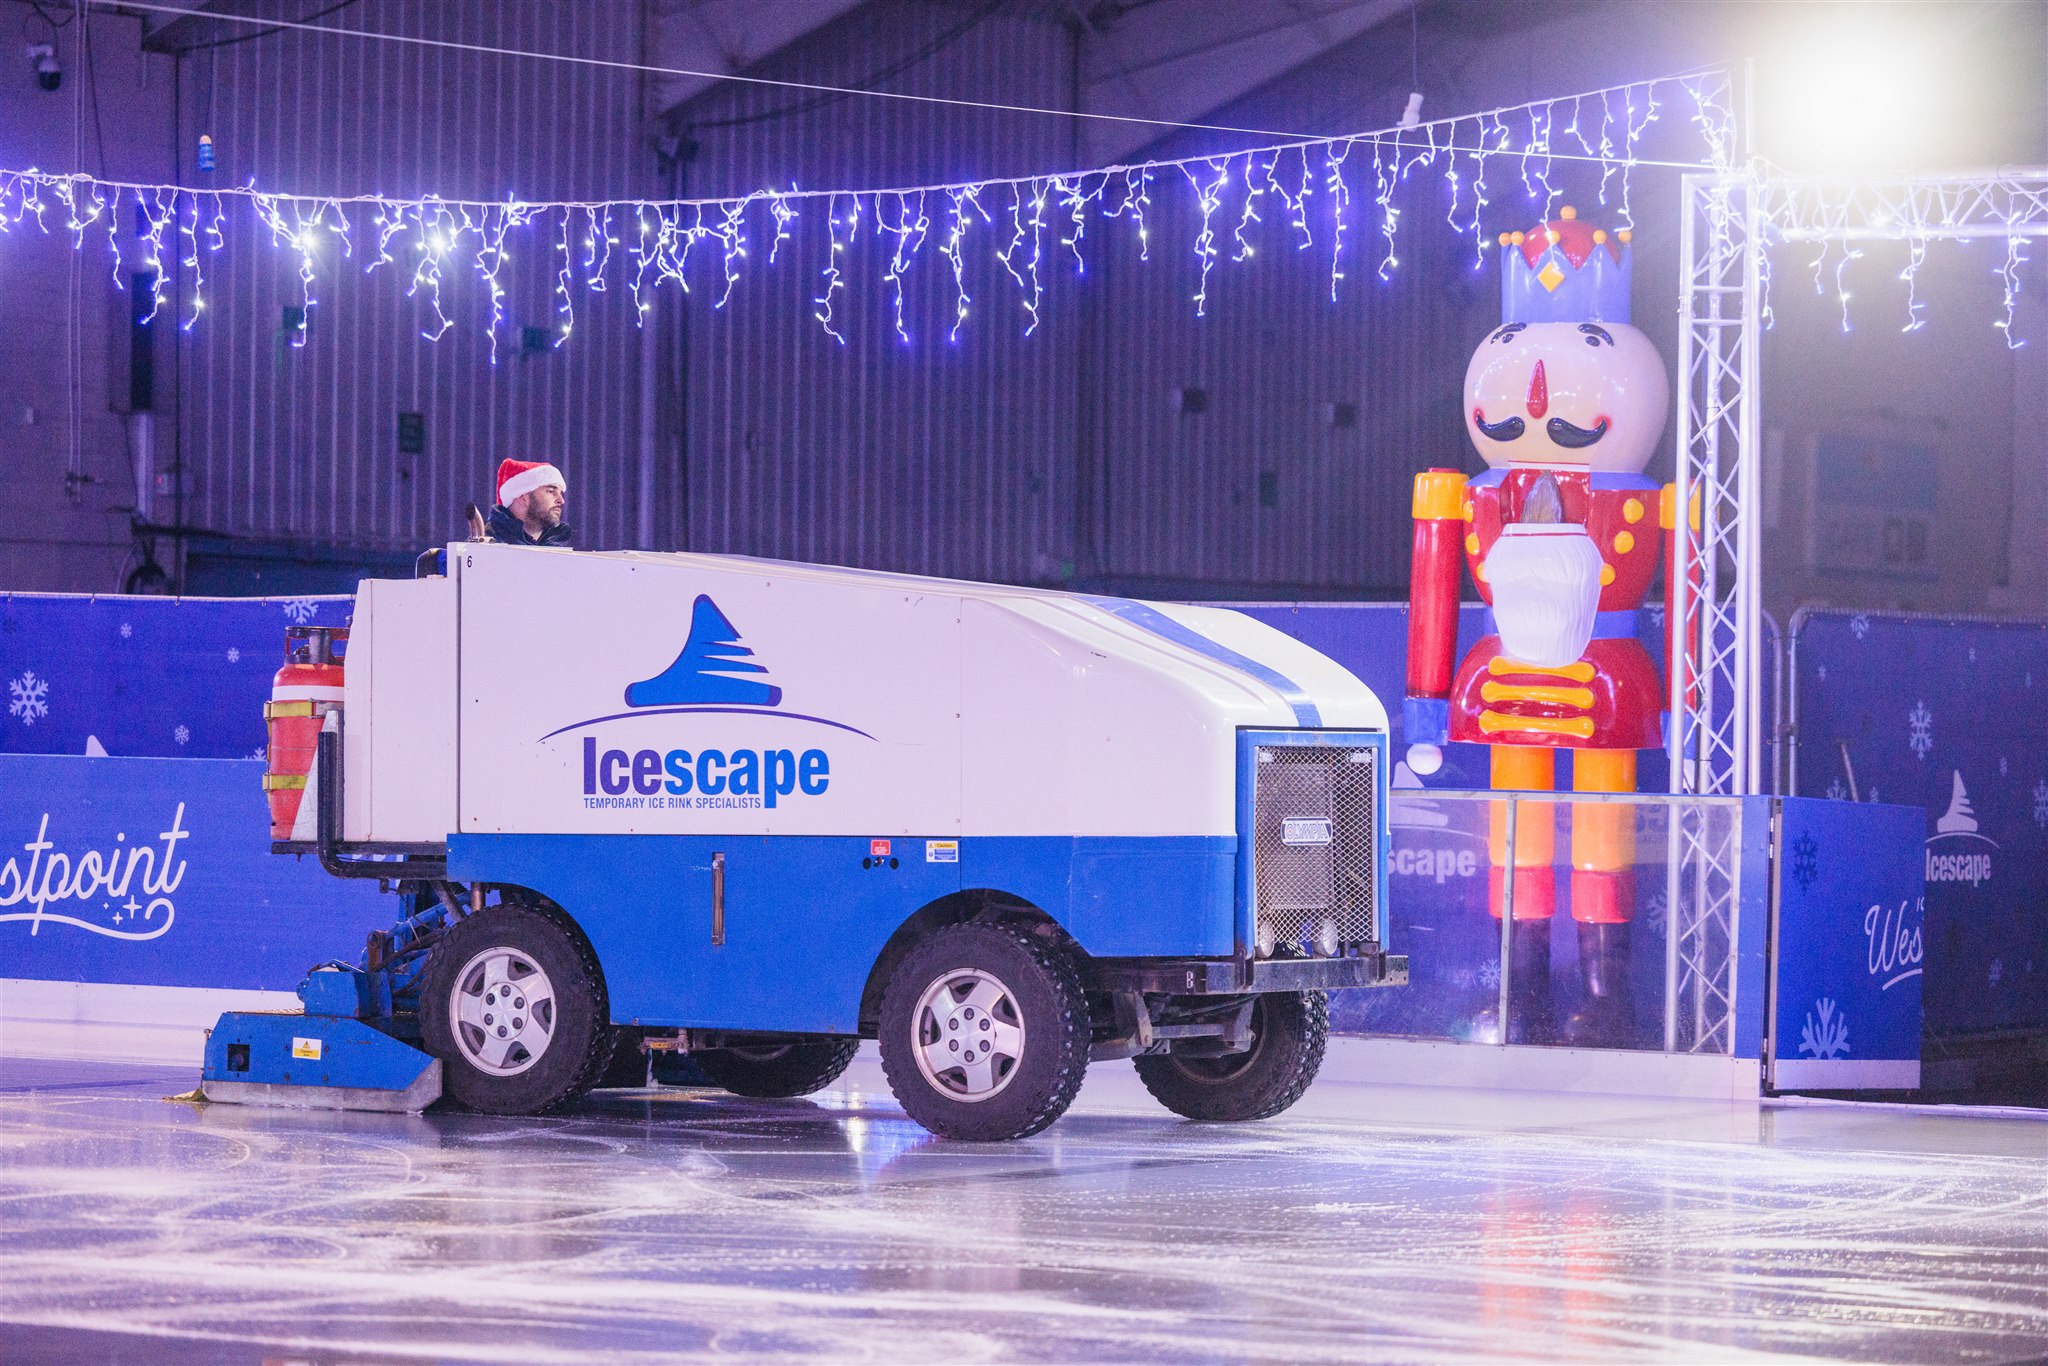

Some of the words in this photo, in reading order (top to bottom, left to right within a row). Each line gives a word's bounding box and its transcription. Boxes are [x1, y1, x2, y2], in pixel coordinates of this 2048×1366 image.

[466, 555, 473, 568] 6
[583, 737, 830, 809] Icescape
[584, 797, 645, 809] TEMPORARY
[648, 797, 665, 809] ICE
[668, 797, 693, 809] RINK
[695, 797, 761, 809] SPECIALISTS
[1925, 848, 1991, 887] Icescape
[1864, 899, 1923, 975] Wes
